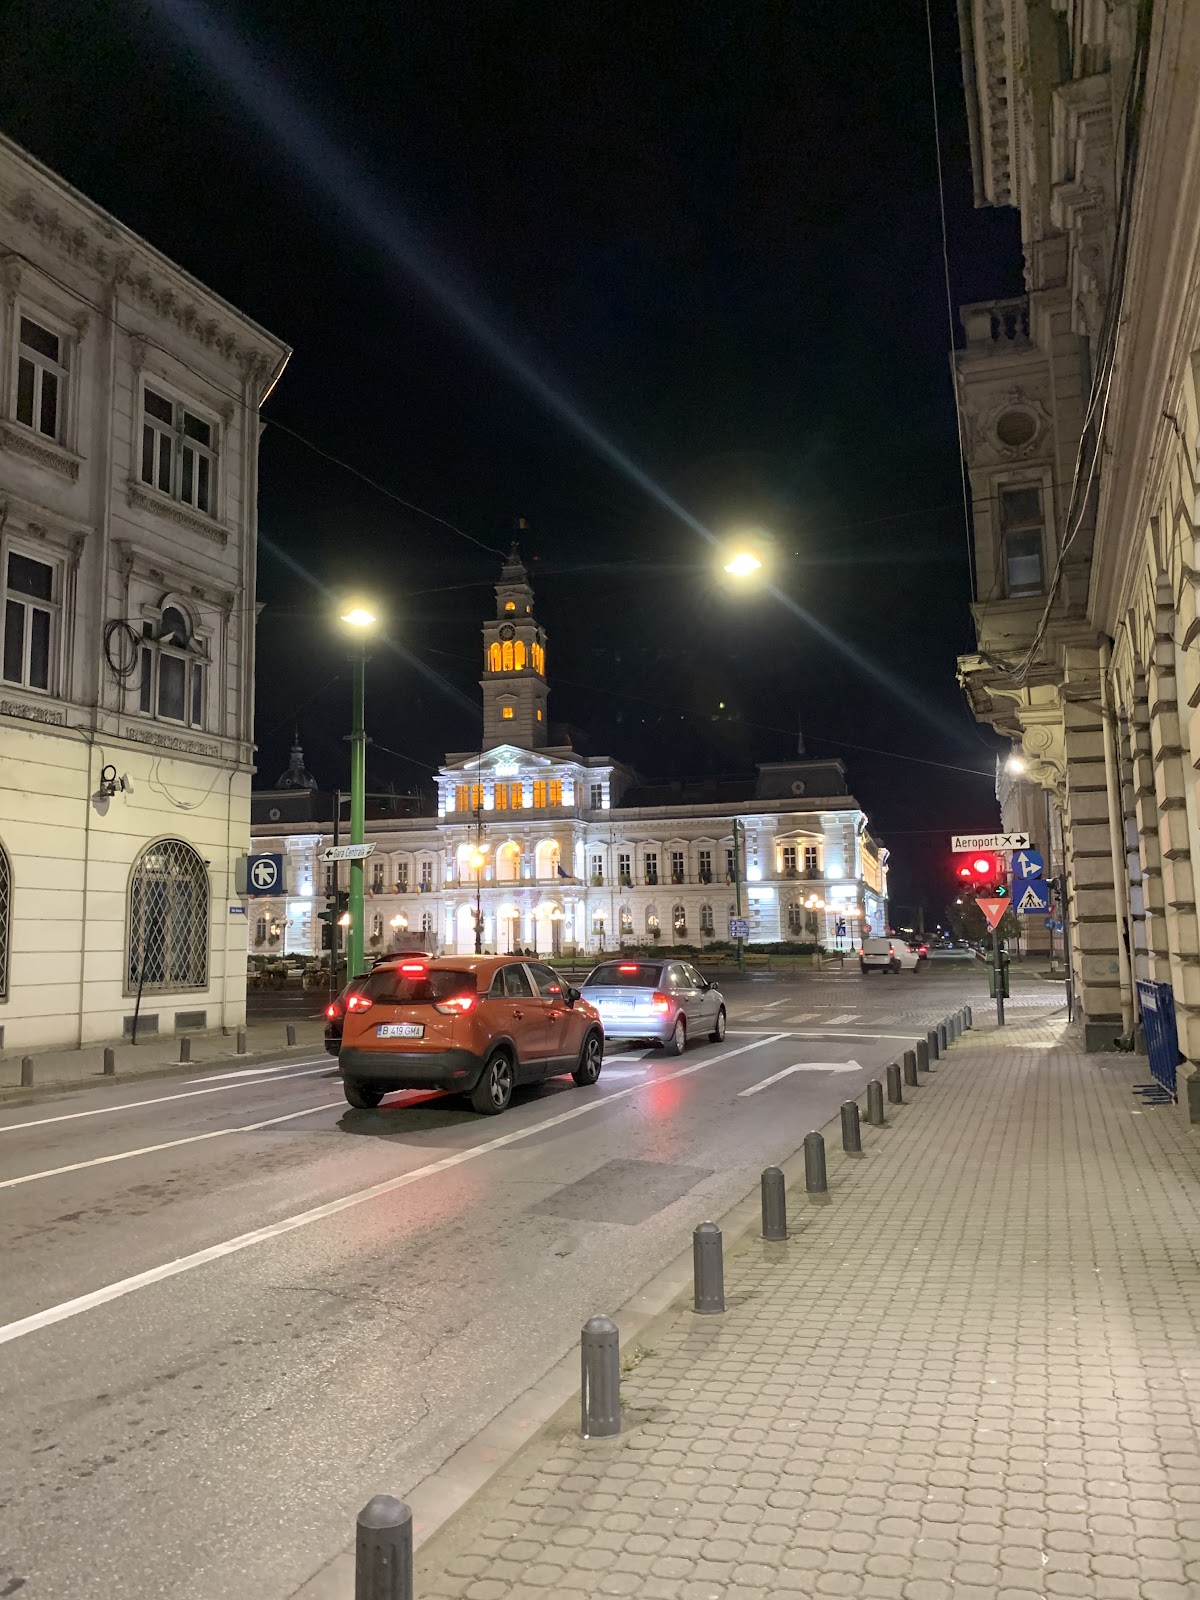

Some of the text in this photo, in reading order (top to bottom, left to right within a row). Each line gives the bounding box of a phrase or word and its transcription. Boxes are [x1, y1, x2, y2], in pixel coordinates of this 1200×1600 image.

[955, 836, 999, 849] Aeroport
[382, 1026, 420, 1035] B 419 GMA
